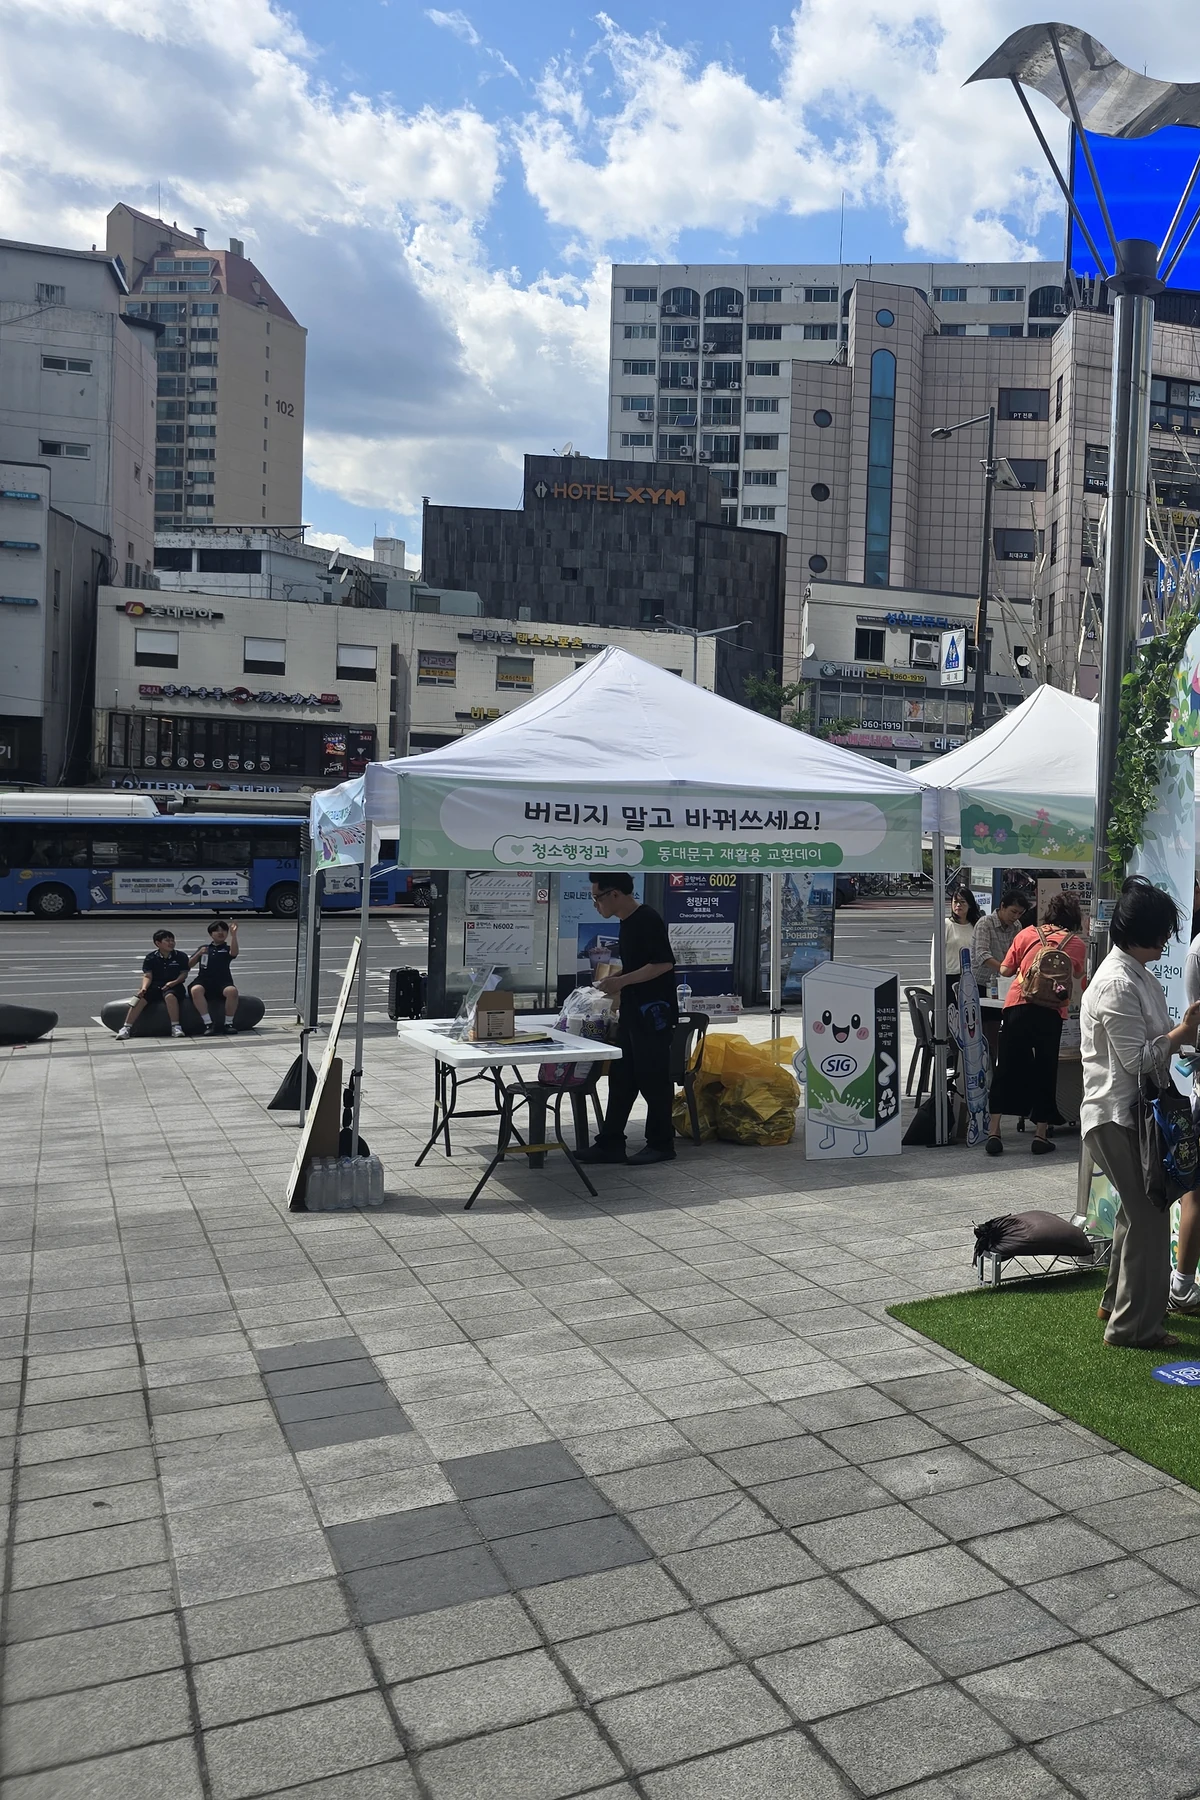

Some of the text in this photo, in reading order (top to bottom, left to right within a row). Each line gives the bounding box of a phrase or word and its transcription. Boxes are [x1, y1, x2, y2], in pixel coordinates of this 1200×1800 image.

[276, 400, 295, 418] 102
[1022, 412, 1034, 420] 전문
[554, 482, 687, 506] HOTEL XYM
[1008, 551, 1030, 560] 최대규모
[150, 604, 214, 621] 롯데리아
[515, 631, 583, 650] 댄스스포츠
[421, 656, 454, 667] 사교댄스
[893, 673, 926, 682] 960-1919
[140, 685, 160, 695] 24시
[862, 720, 901, 730] 960-1919
[524, 801, 821, 833] 버리지 말고 바꿔쓰세요!
[531, 842, 611, 861] 청소행정과
[657, 844, 823, 864] 동대문구 재활용 교환데이
[684, 874, 737, 887] 공항버스 6002
[1060, 881, 1092, 891] 탄소중립
[686, 896, 719, 907] 청량리역
[1151, 964, 1182, 980] 실천이
[826, 1059, 851, 1072] SIG
